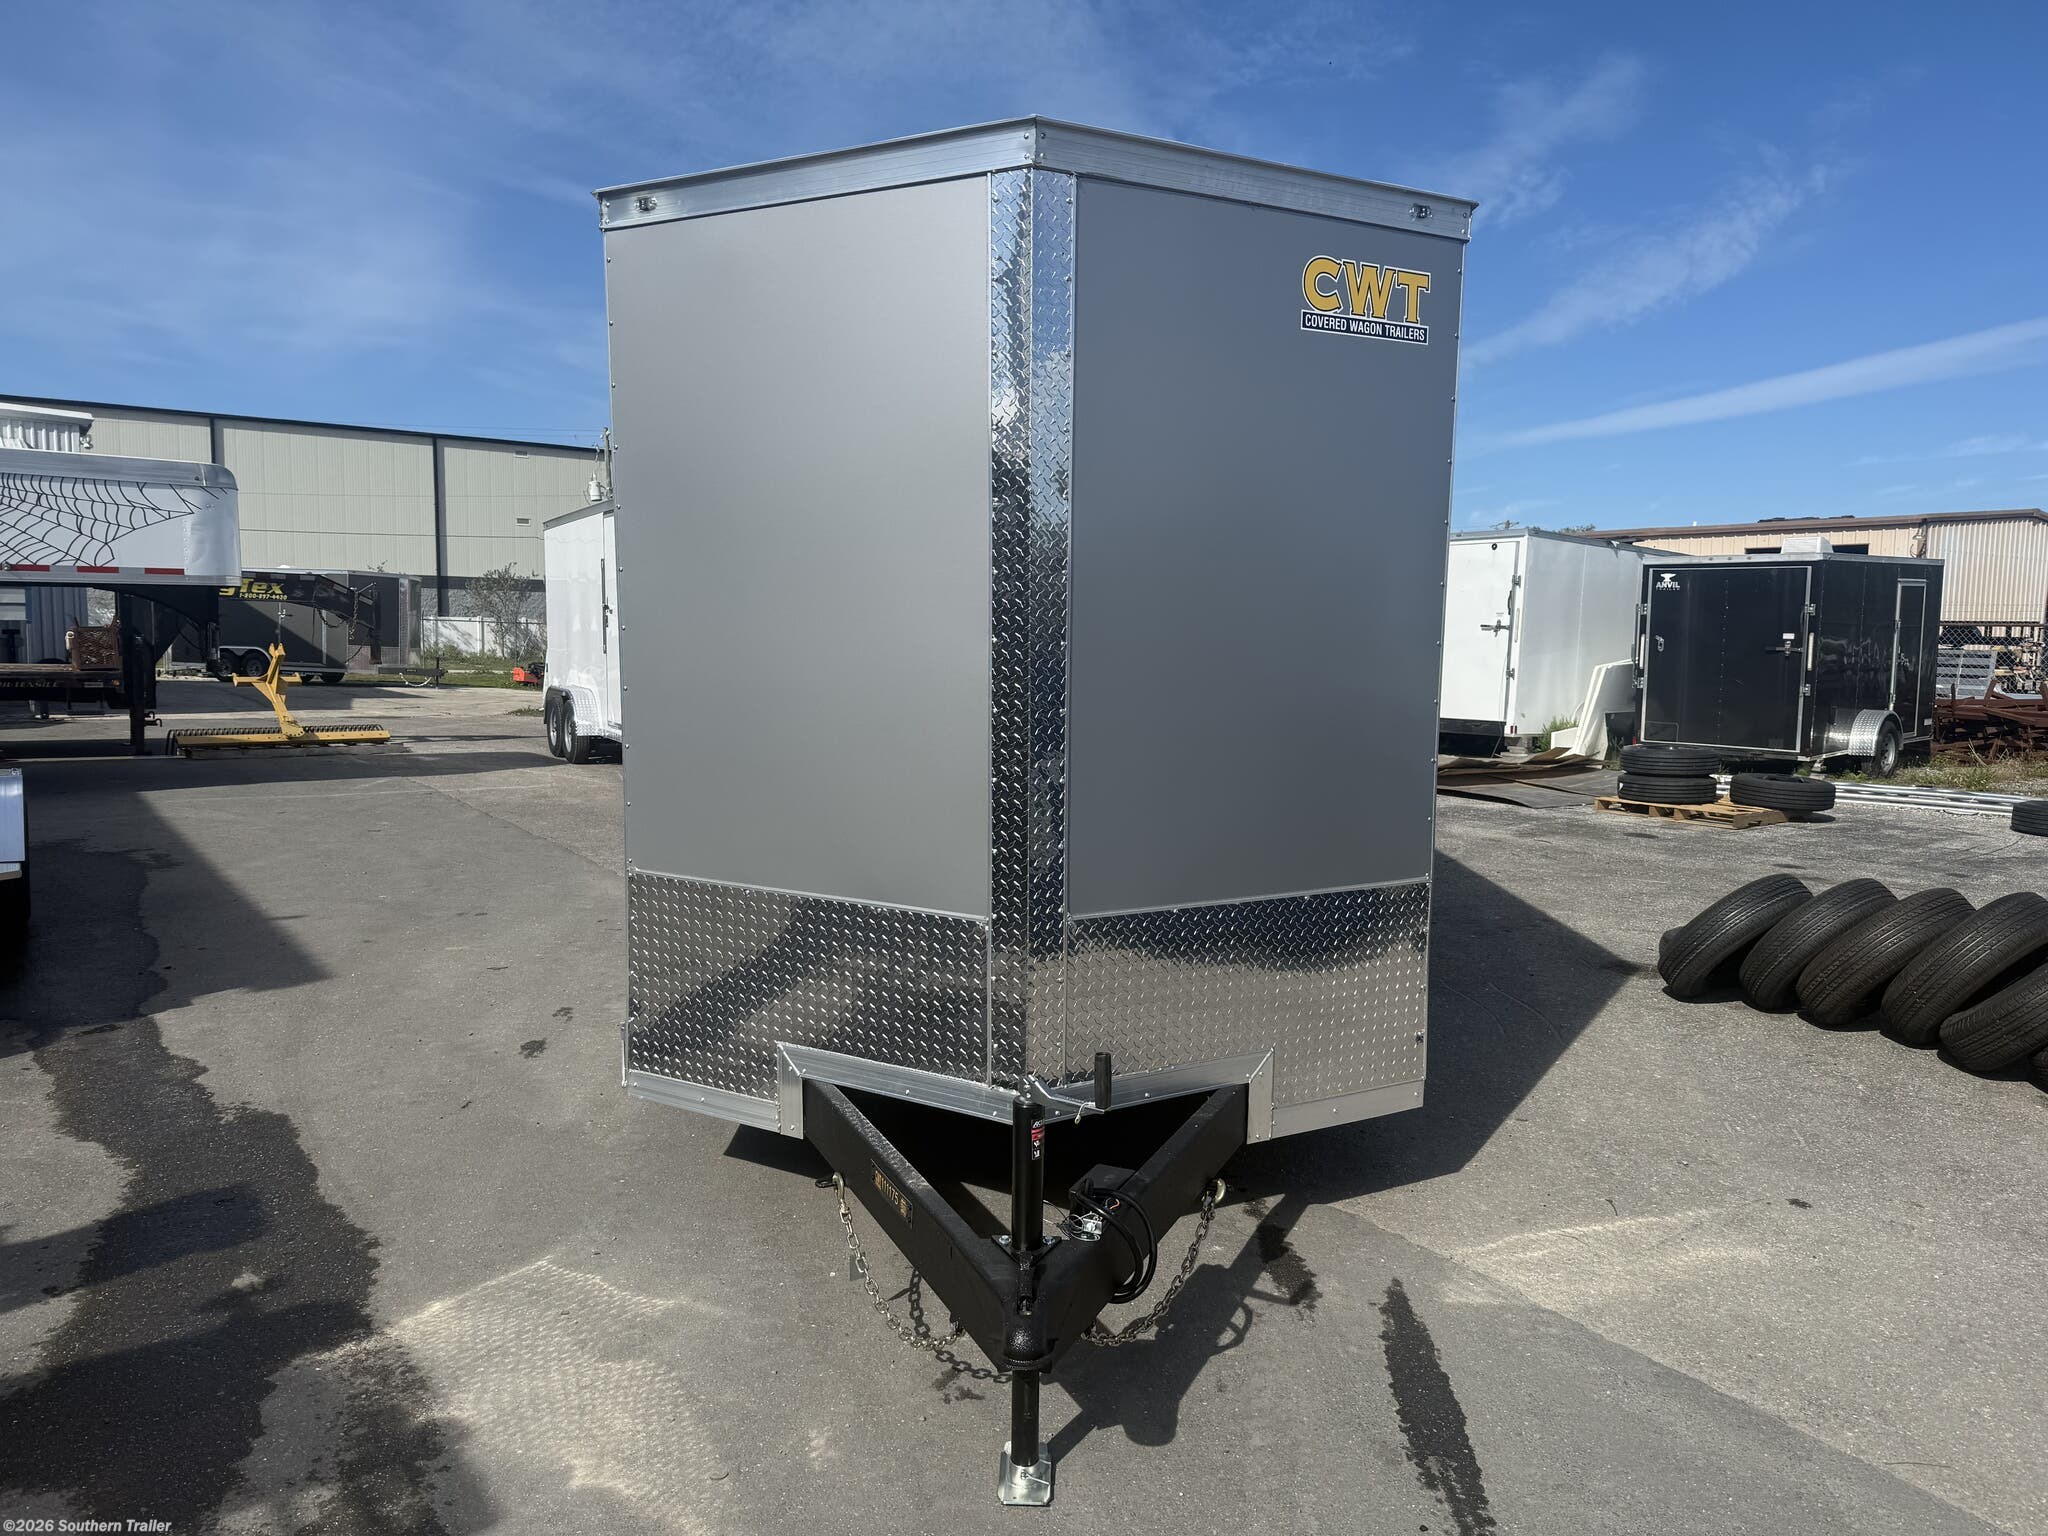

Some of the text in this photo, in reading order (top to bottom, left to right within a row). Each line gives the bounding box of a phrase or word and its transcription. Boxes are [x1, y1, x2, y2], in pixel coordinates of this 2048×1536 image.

[1303, 256, 1430, 325] CWT
[1305, 313, 1425, 341] COVERED WAGON TRAILERS
